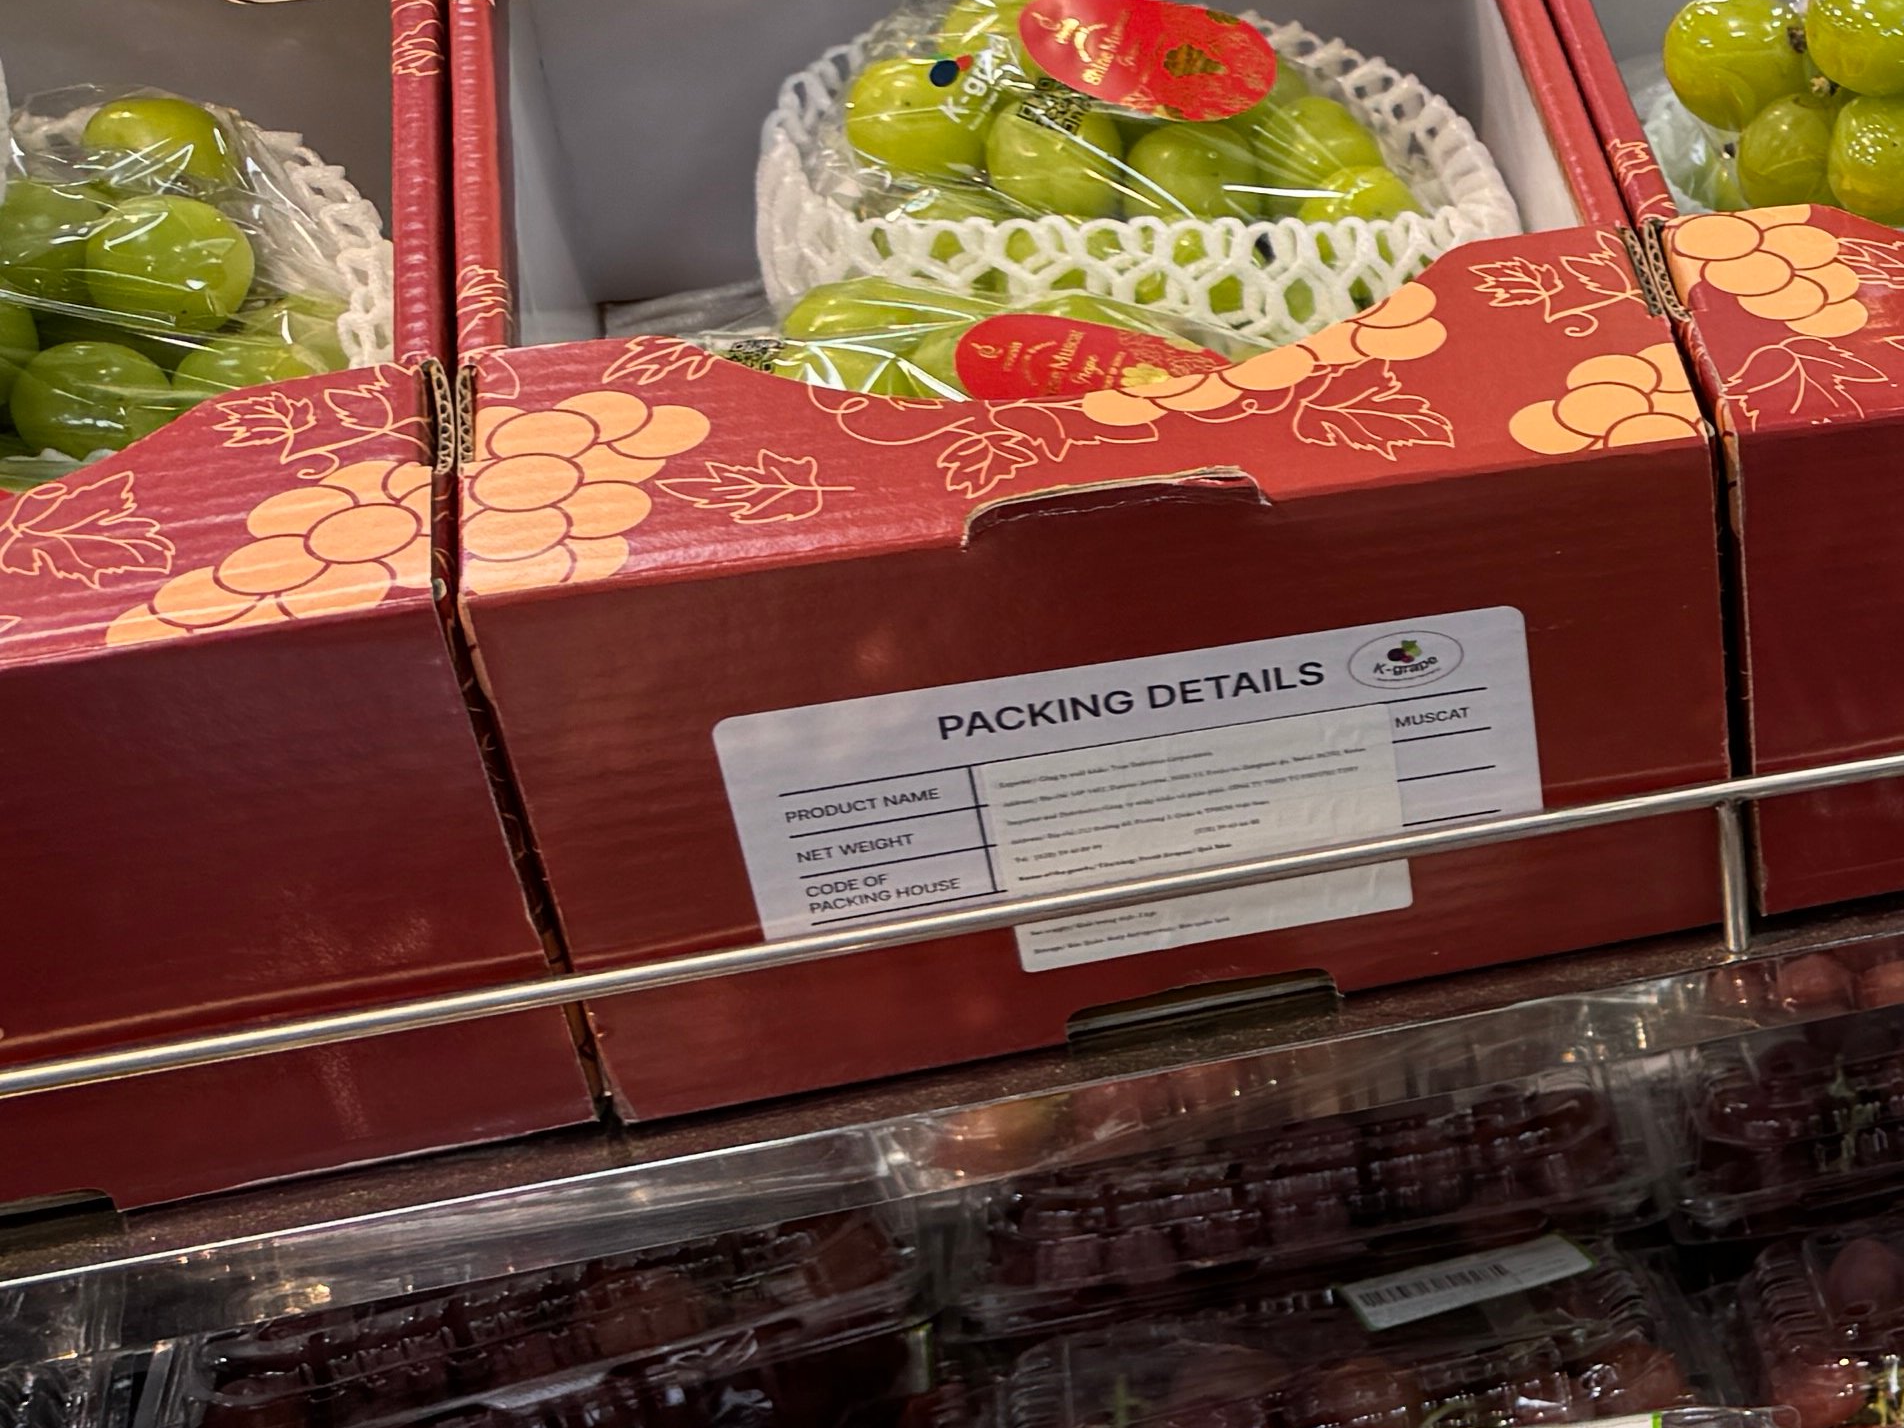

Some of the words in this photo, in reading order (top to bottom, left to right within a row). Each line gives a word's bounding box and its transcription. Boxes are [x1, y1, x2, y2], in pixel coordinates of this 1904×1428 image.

[1373, 655, 1438, 676] K-grape
[937, 688, 1136, 741] PACKING
[1147, 661, 1326, 710] DETAILS
[1394, 707, 1470, 728] MUSCAT
[785, 797, 878, 823] PRODUCT
[883, 788, 941, 807] NAME
[796, 847, 833, 863] NET
[838, 833, 914, 855] WEIGHT
[805, 878, 859, 897] CODE
[862, 874, 889, 887] OF
[809, 890, 892, 914] PACKING
[895, 878, 961, 898] HOUSE
